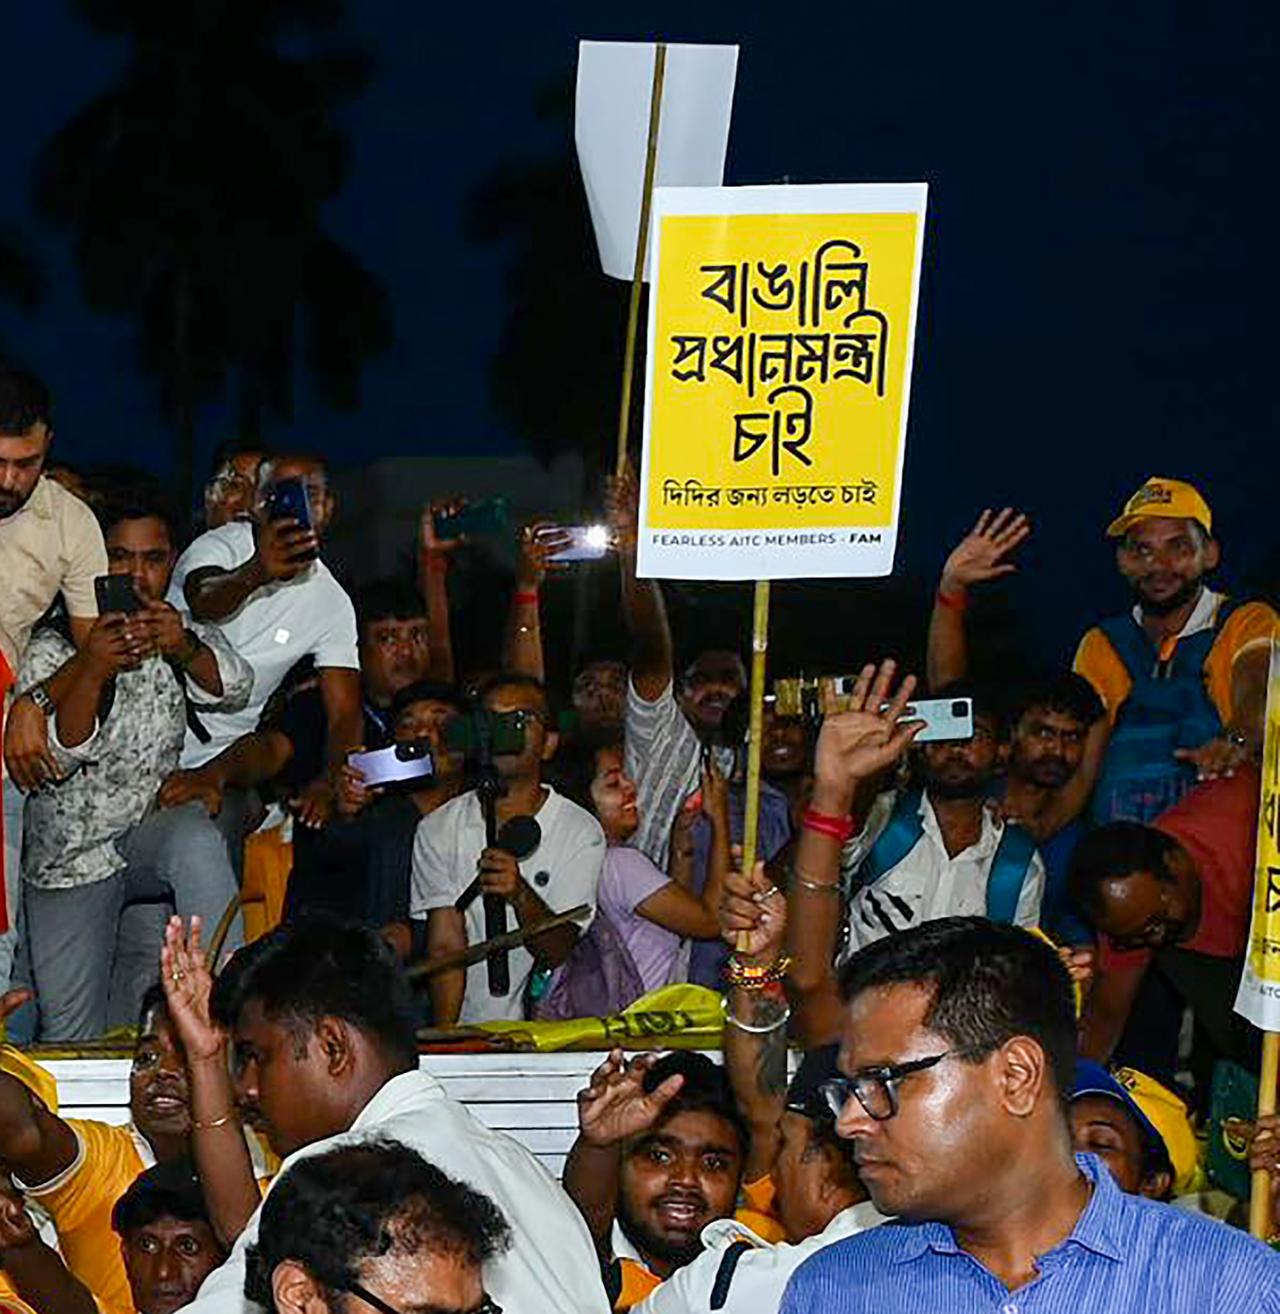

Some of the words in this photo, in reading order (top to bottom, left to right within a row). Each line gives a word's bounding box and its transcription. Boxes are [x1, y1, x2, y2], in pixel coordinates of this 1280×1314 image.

[700, 239, 868, 328] বাঙালি
[671, 309, 888, 397] প্রধানমন্ত্রী
[733, 385, 813, 476] চাই
[662, 478, 720, 508] দিদির
[726, 486, 768, 506] জন্য
[840, 478, 878, 505] চাই
[652, 534, 726, 547] FEARLESS
[729, 534, 760, 547] AITC
[764, 532, 836, 546] MEMBERS
[849, 532, 883, 544] FAM
